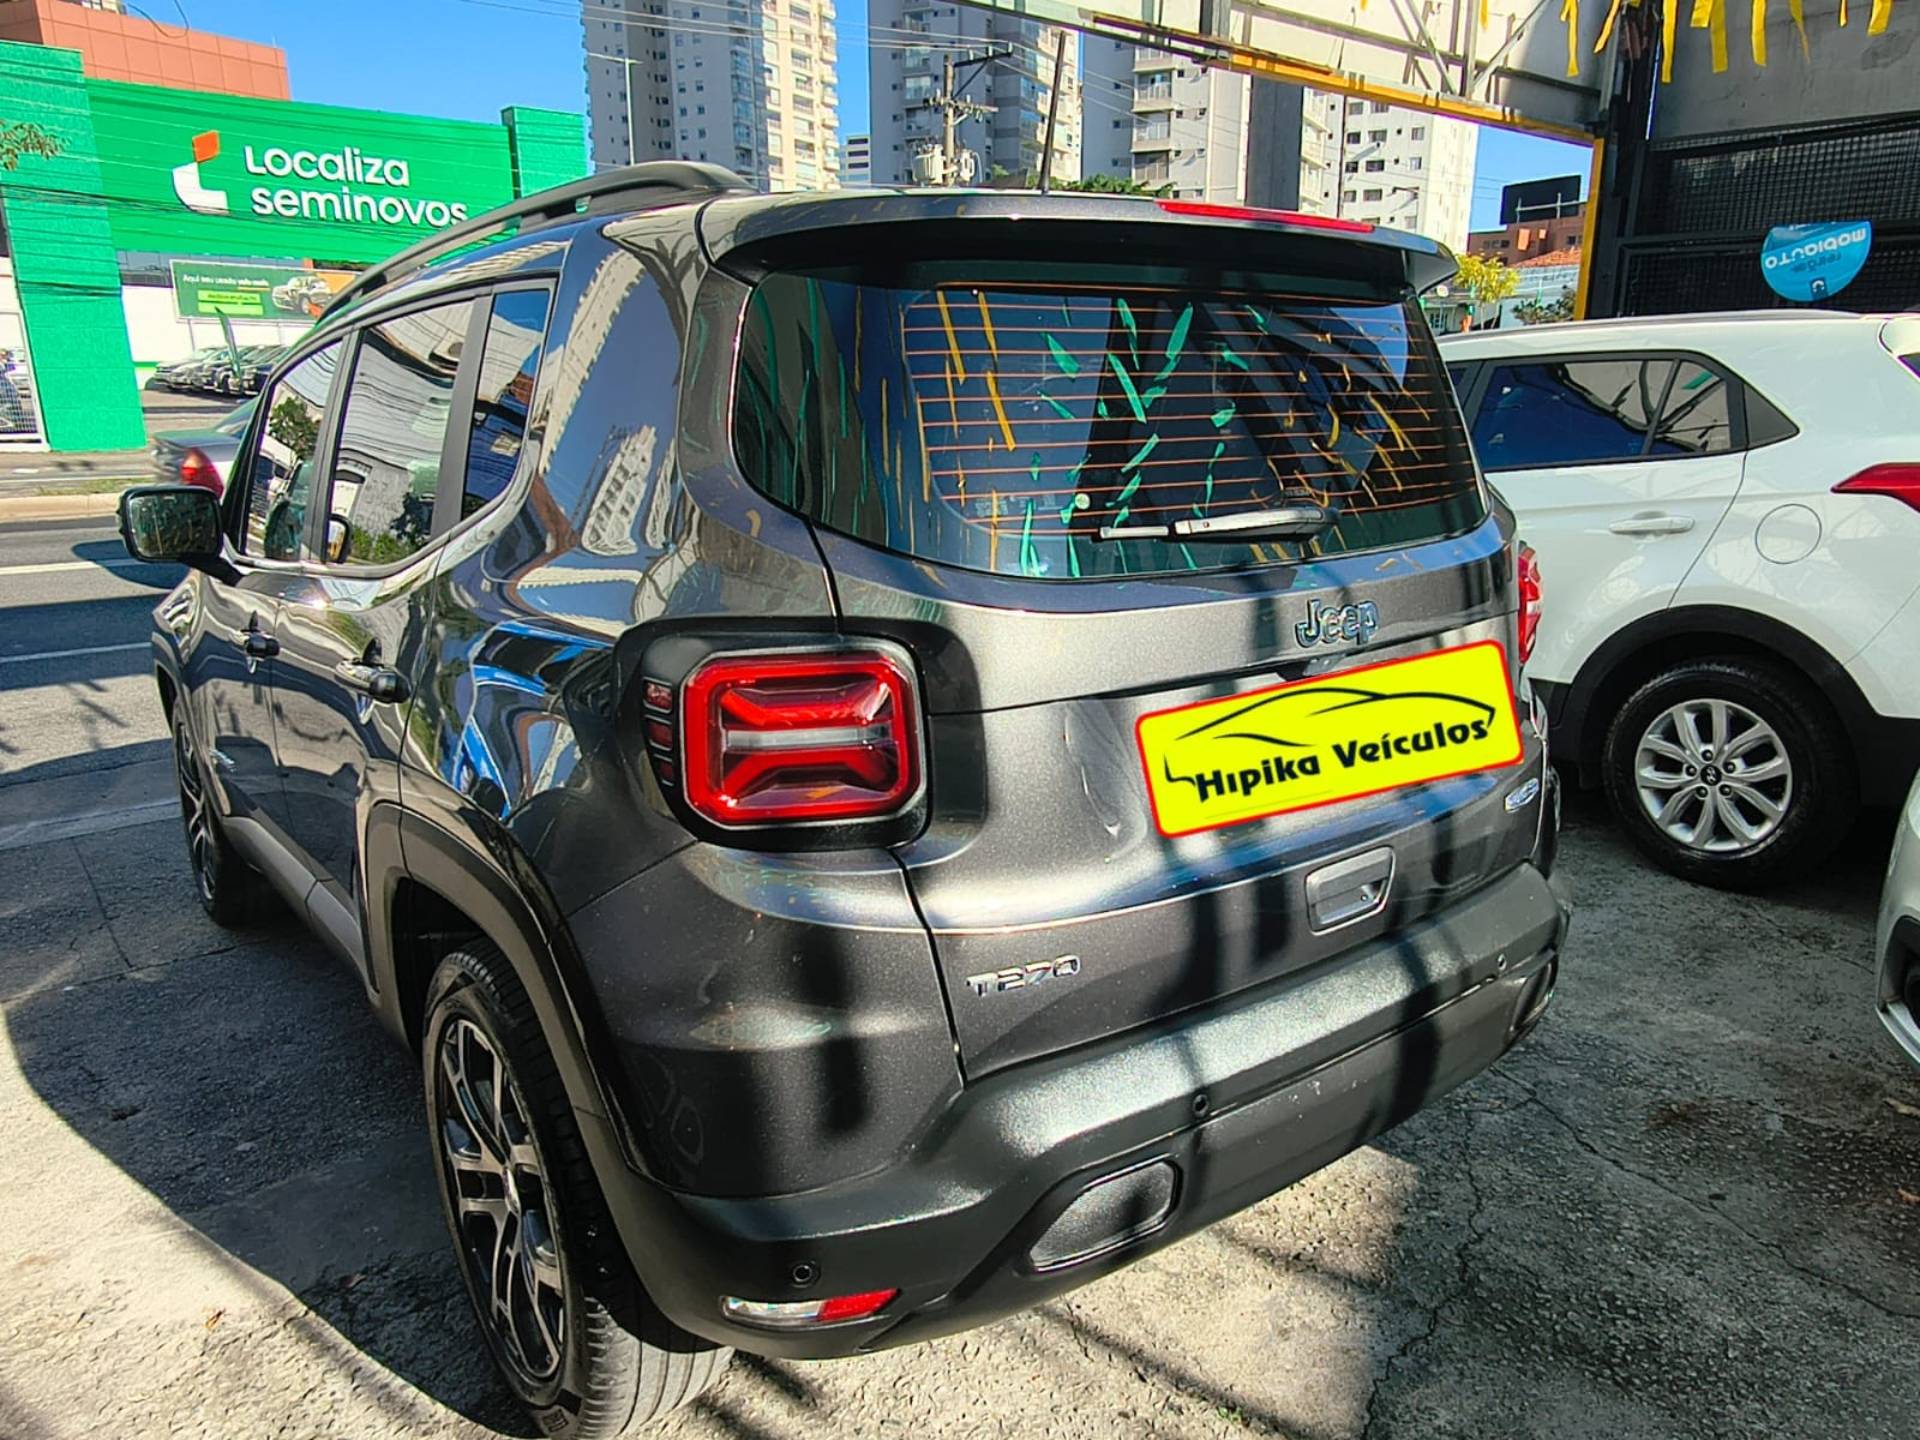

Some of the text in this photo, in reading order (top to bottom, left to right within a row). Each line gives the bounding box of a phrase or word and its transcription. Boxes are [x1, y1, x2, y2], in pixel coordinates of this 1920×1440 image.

[244, 145, 409, 187] Localiza
[251, 186, 468, 228] seminovos
[1295, 598, 1378, 647] Jeep
[966, 955, 1081, 997] T270
